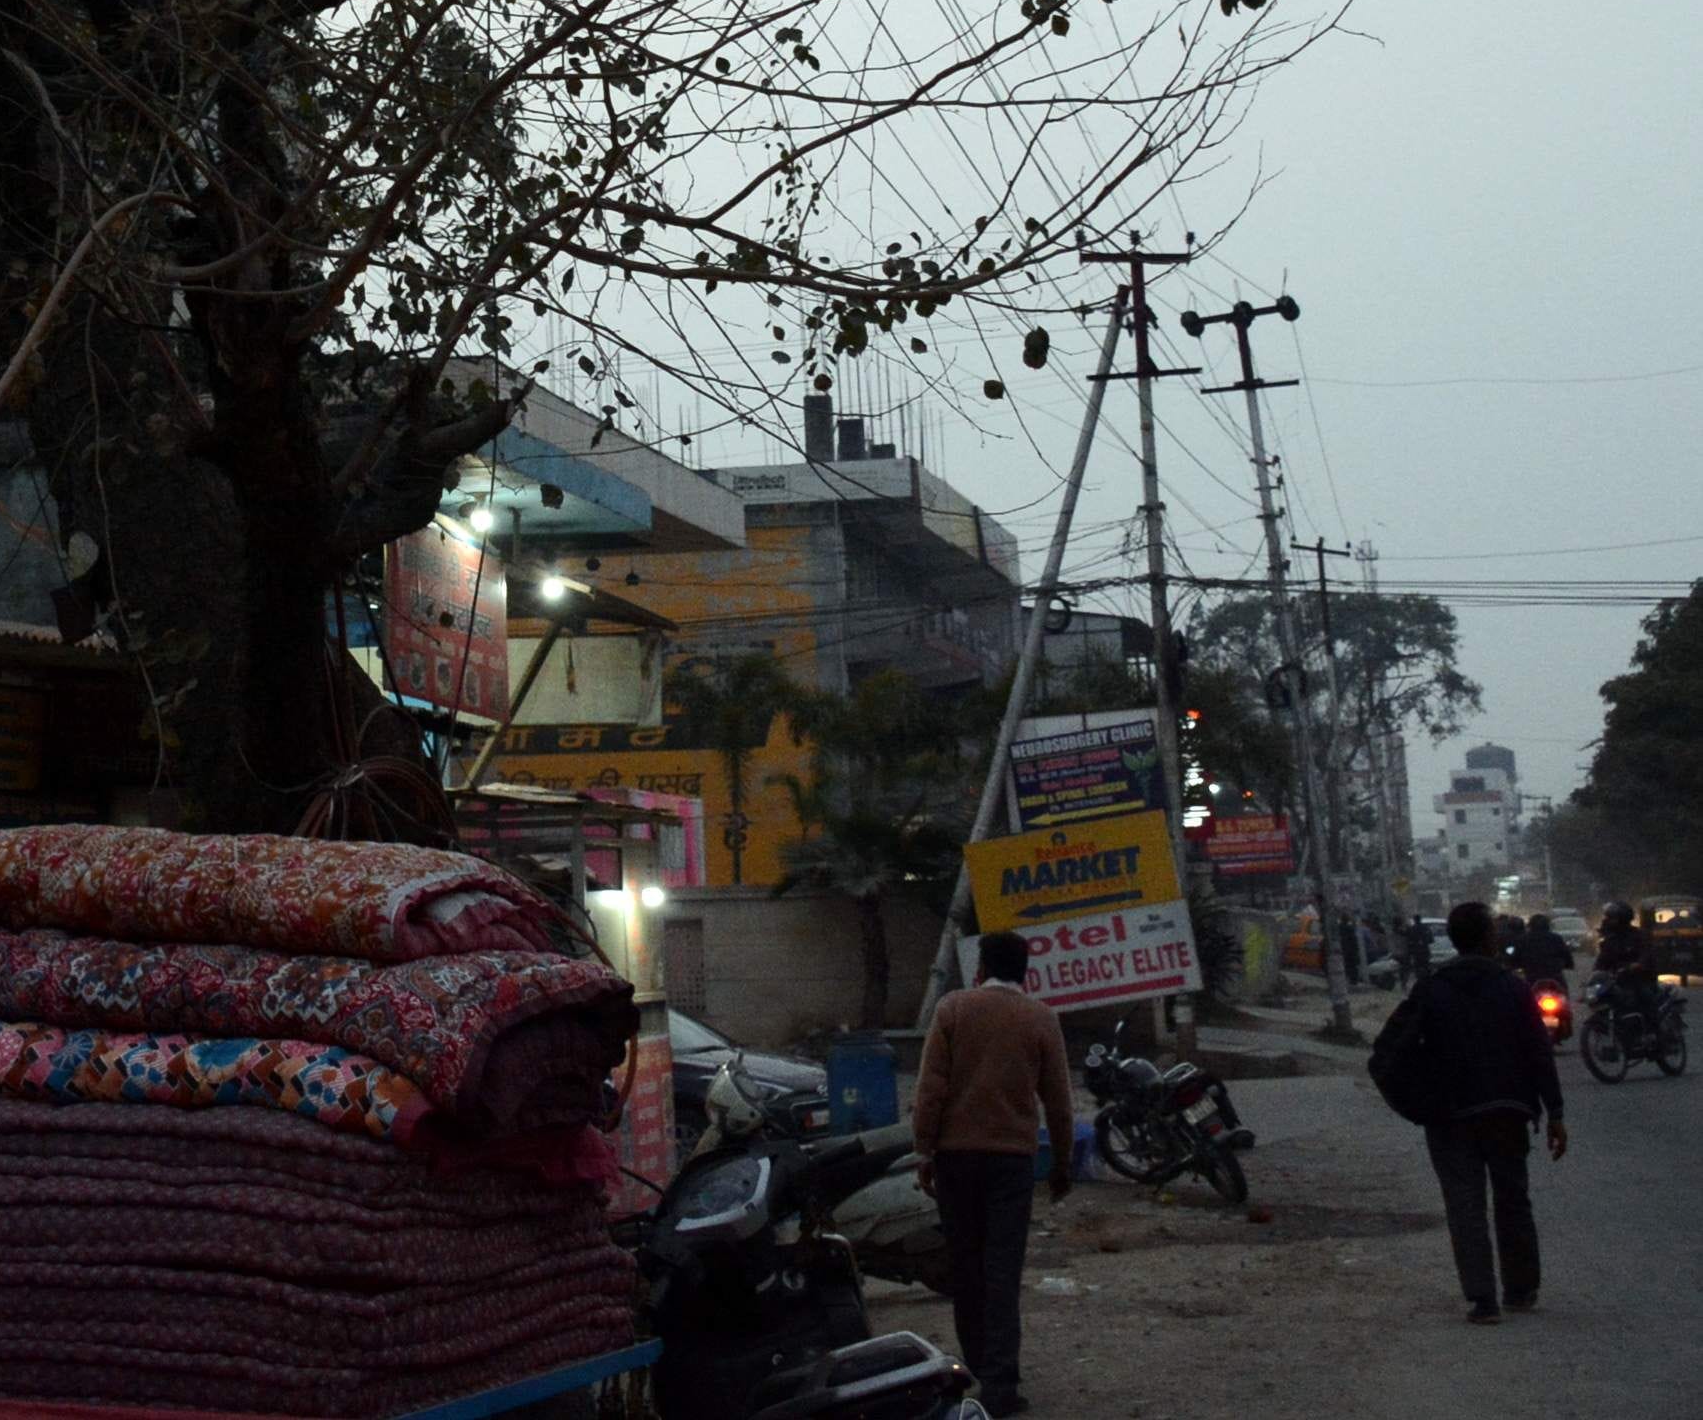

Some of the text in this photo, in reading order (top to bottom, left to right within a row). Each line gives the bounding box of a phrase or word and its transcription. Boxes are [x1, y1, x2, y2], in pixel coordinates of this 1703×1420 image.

[1010, 722, 1153, 760] NEUROSURGERY CLINIC
[1001, 845, 1140, 897] MARKET
[1026, 915, 1128, 957] otel
[1046, 952, 1125, 990] LEGACY
[1131, 941, 1192, 974] ELITE
